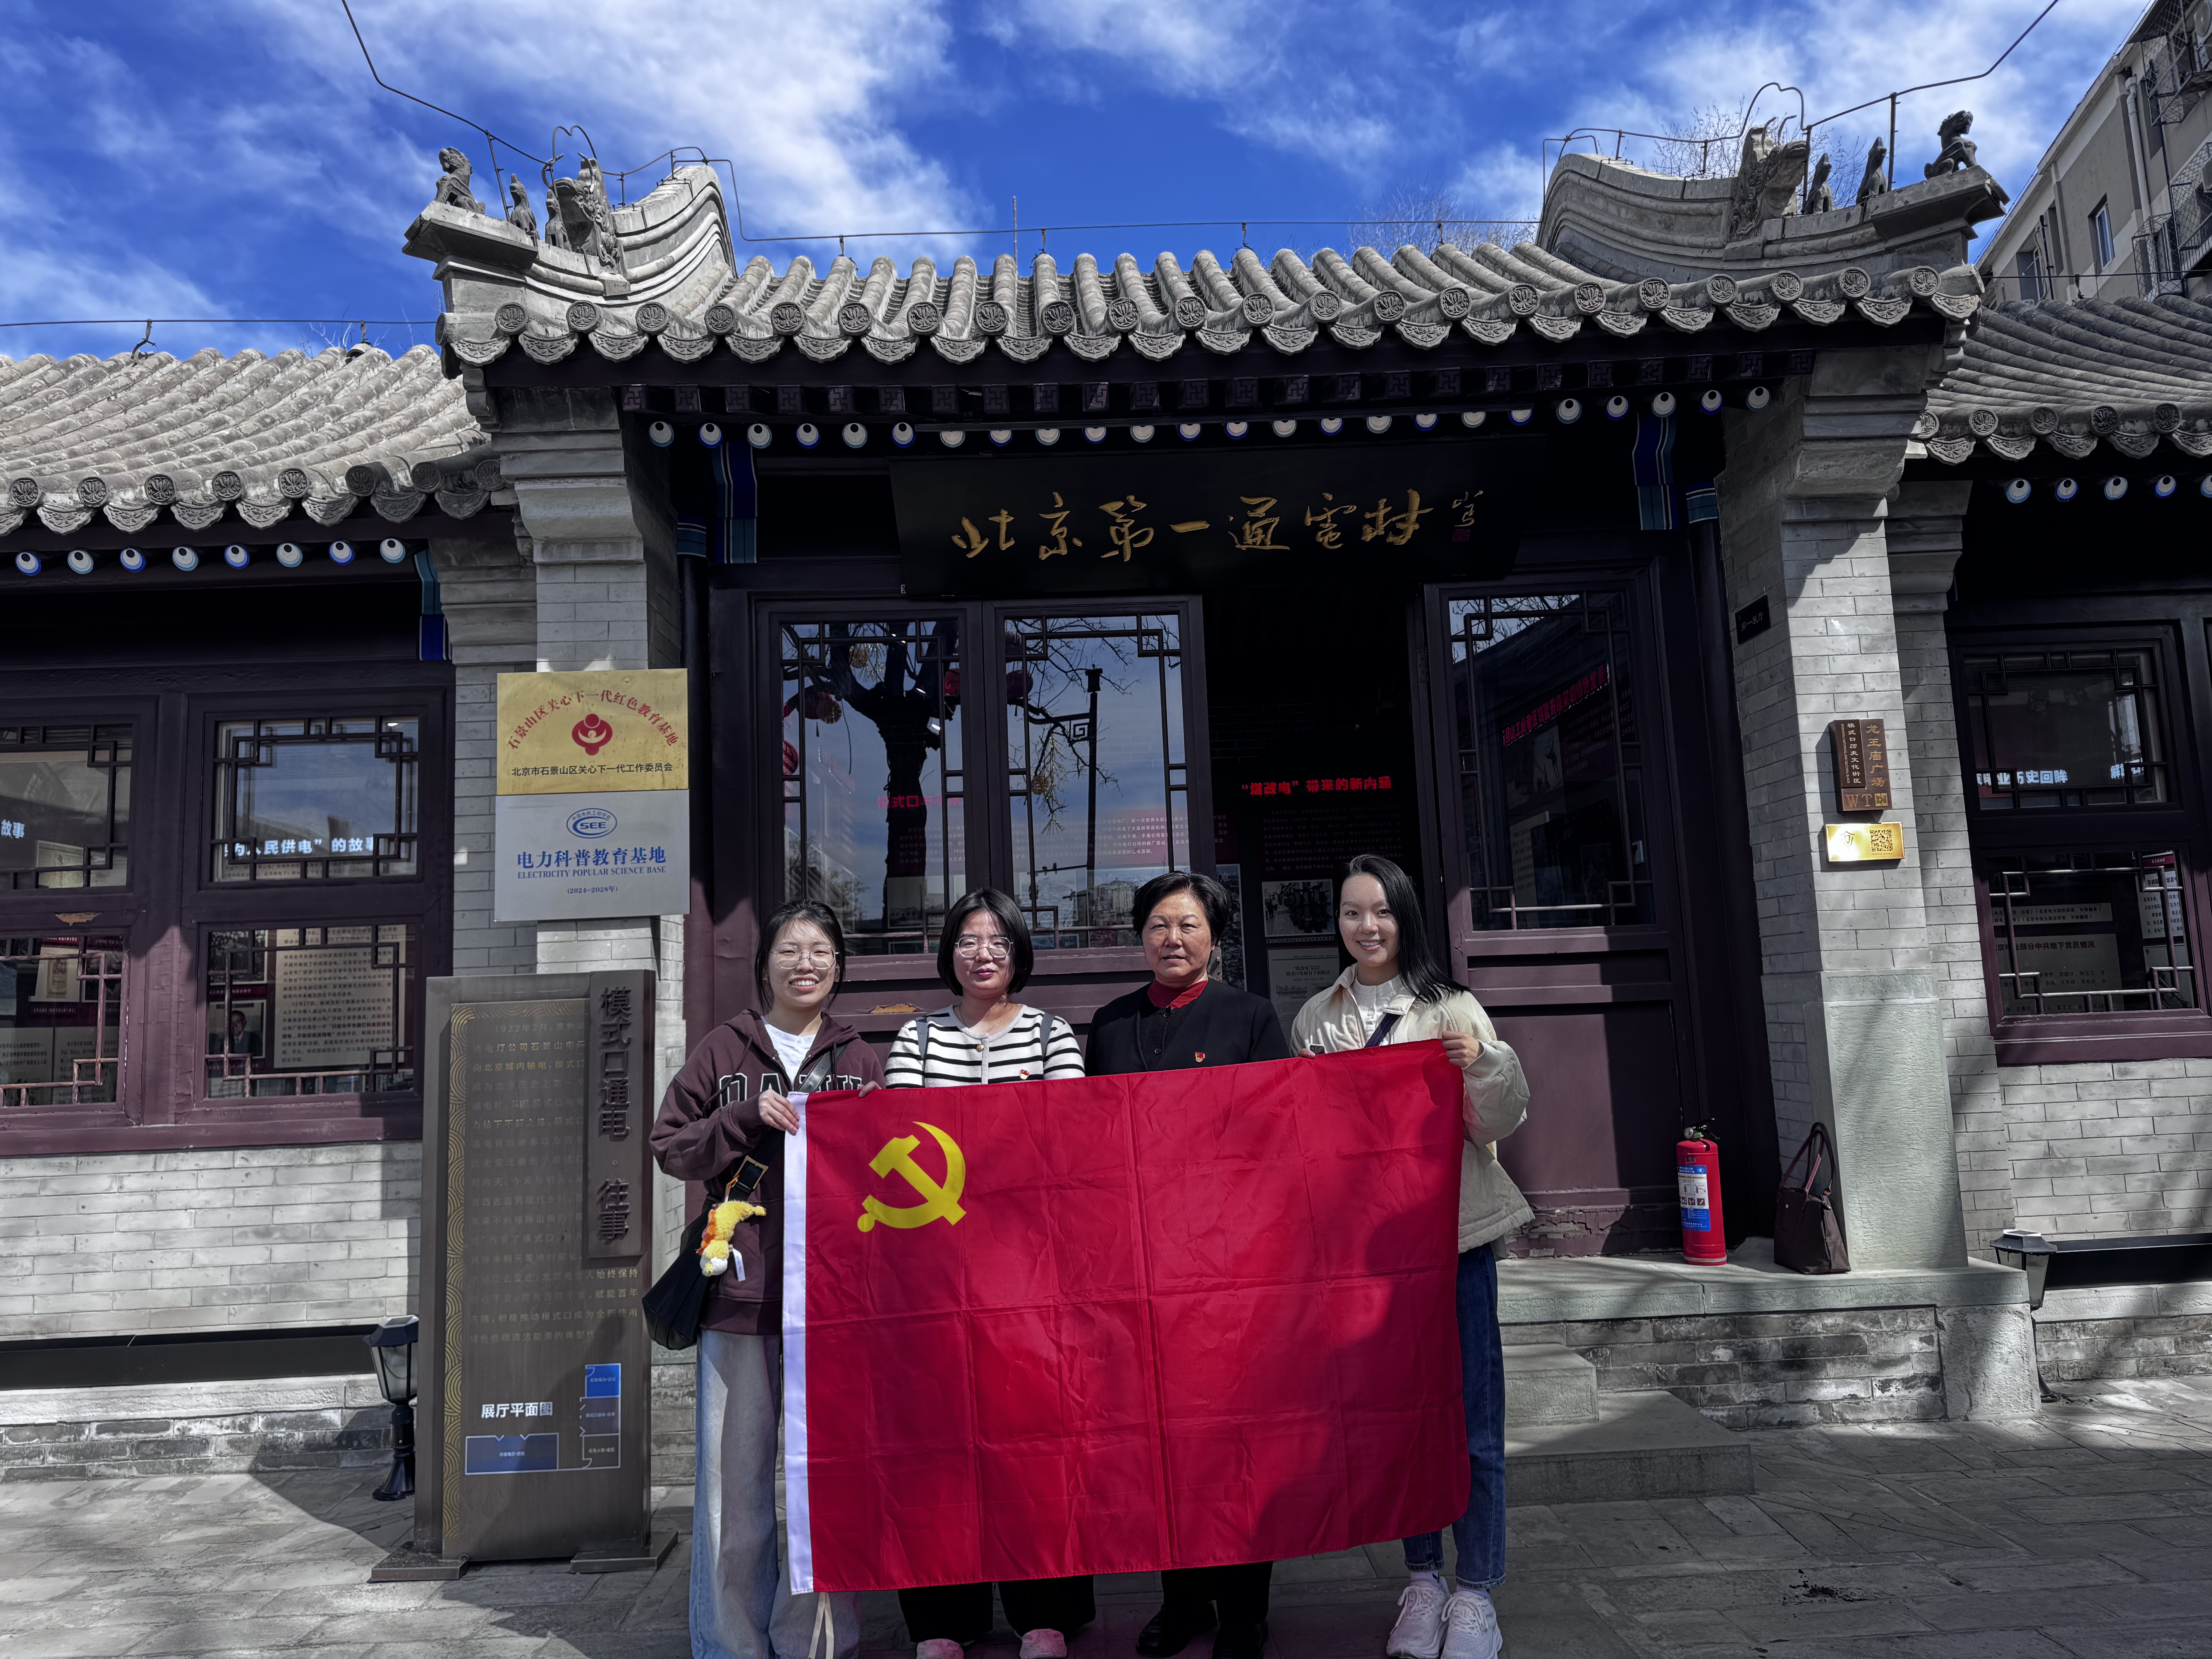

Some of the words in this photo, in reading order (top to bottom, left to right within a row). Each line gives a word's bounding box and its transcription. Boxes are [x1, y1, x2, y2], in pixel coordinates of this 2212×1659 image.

[507, 690, 679, 750] 石景山区关心下一代红色教育基地
[1847, 723, 1861, 783] 模式口历史文化街区
[1866, 725, 1885, 787] 龙王庙广场
[512, 763, 673, 776] 北京市石景山区关心下一代工作委员会
[1, 819, 25, 839] 故事
[518, 846, 666, 869] 电力科普教育基地
[518, 870, 570, 879] ELECTRICITY
[573, 869, 608, 877] POPULAR
[611, 867, 644, 875] SCIENCE
[481, 1401, 553, 1419] 展厅平面图
